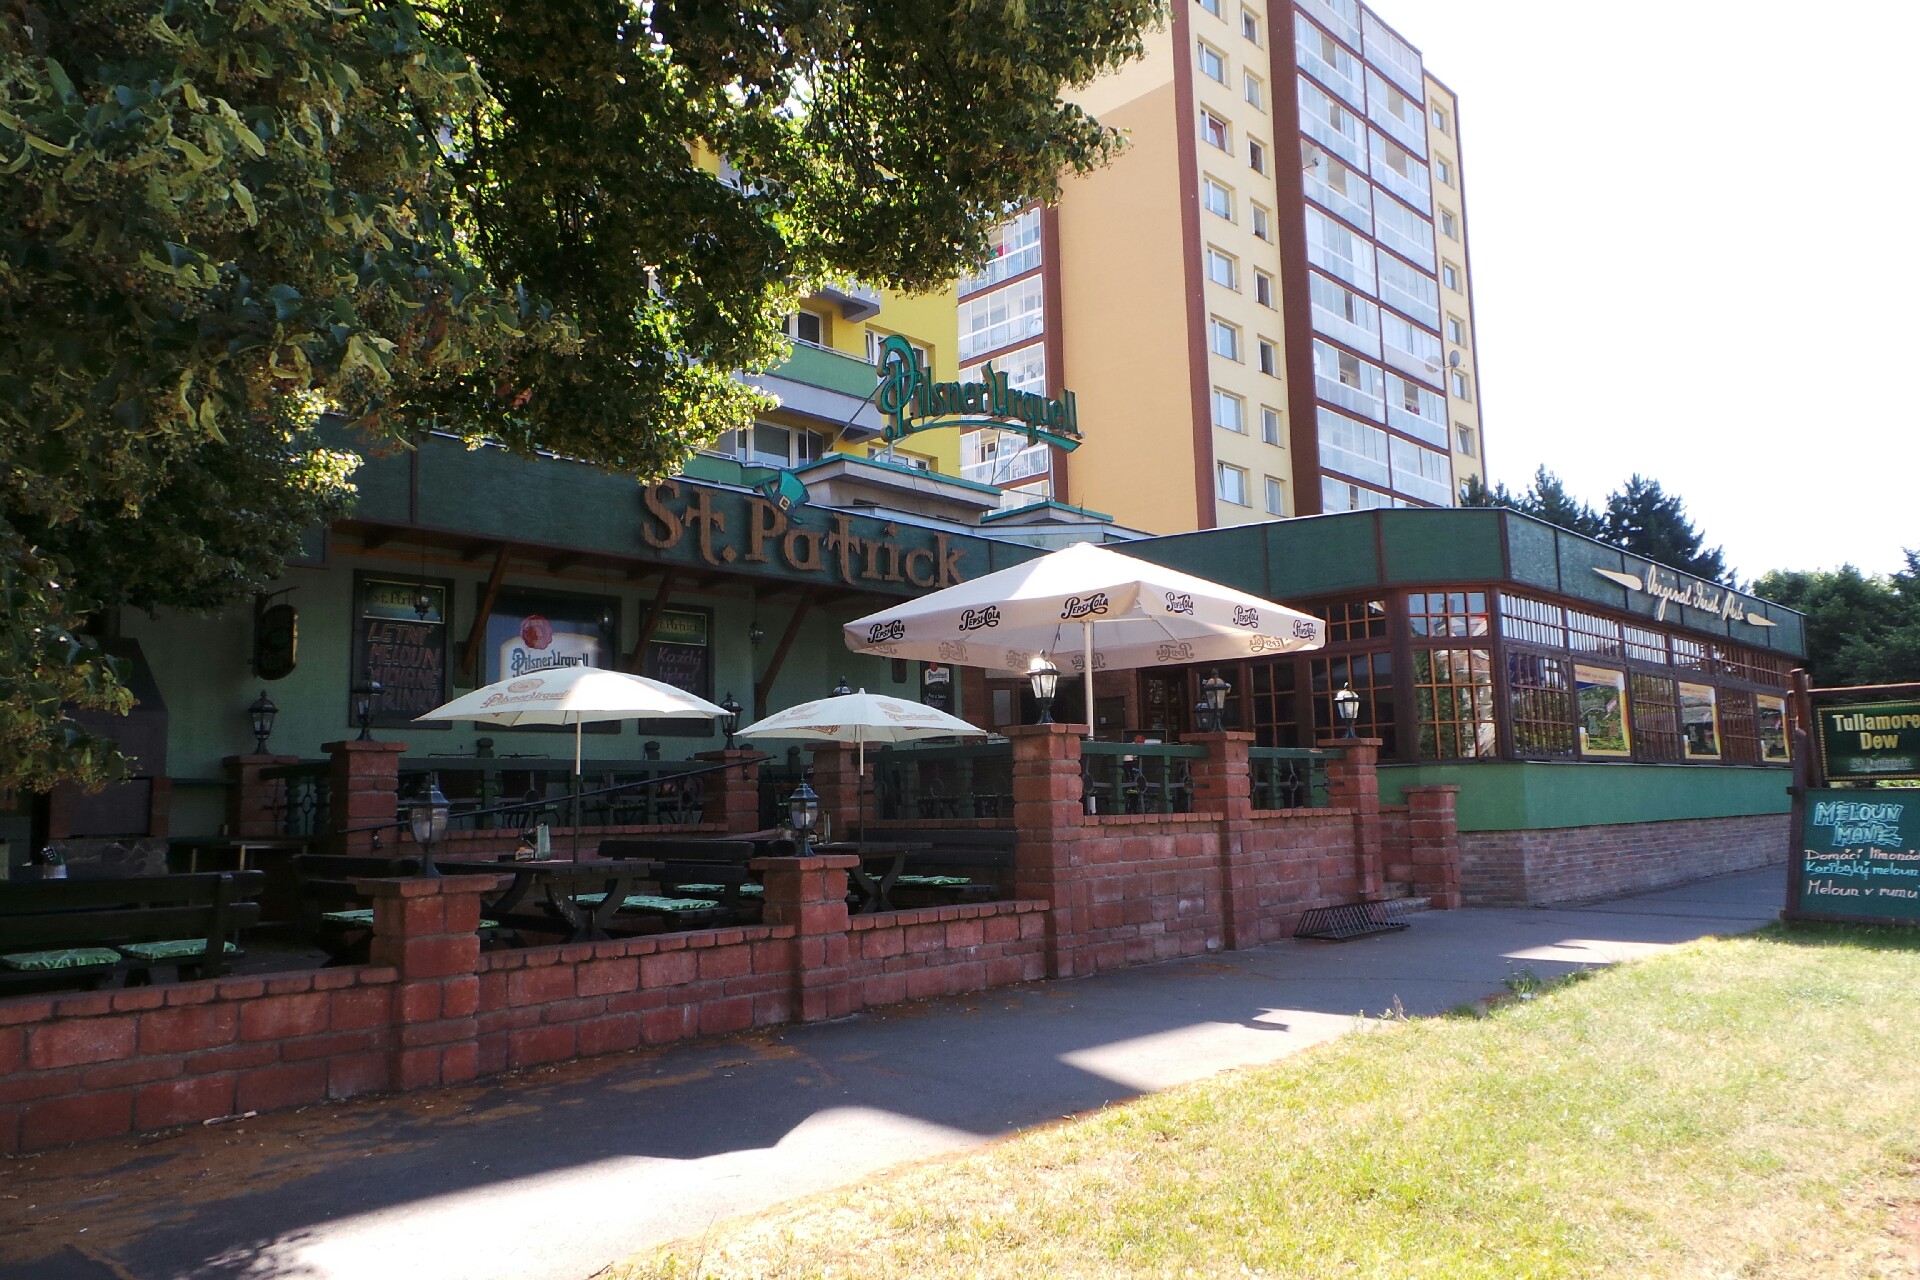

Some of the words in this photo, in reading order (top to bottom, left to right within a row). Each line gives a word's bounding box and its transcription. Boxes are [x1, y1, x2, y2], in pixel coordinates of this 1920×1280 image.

[876, 335, 989, 442] Pilsner
[981, 361, 1080, 446] Urquell
[642, 479, 737, 566] St.
[745, 496, 969, 588] Patrick
[1647, 565, 1692, 621] Original
[1694, 581, 1720, 614] Irish
[511, 648, 551, 678] Pilsner
[480, 693, 532, 709] Pilsner
[1832, 713, 1920, 731] Tullamore
[1860, 732, 1899, 750] Dew
[1813, 801, 1904, 826] MELOUN
[1804, 848, 1863, 860] Domácí
[1873, 862, 1919, 876] meloun
[1807, 880, 1860, 896] Meloun
[1864, 888, 1875, 896] v
[1879, 887, 1919, 899] rumu
